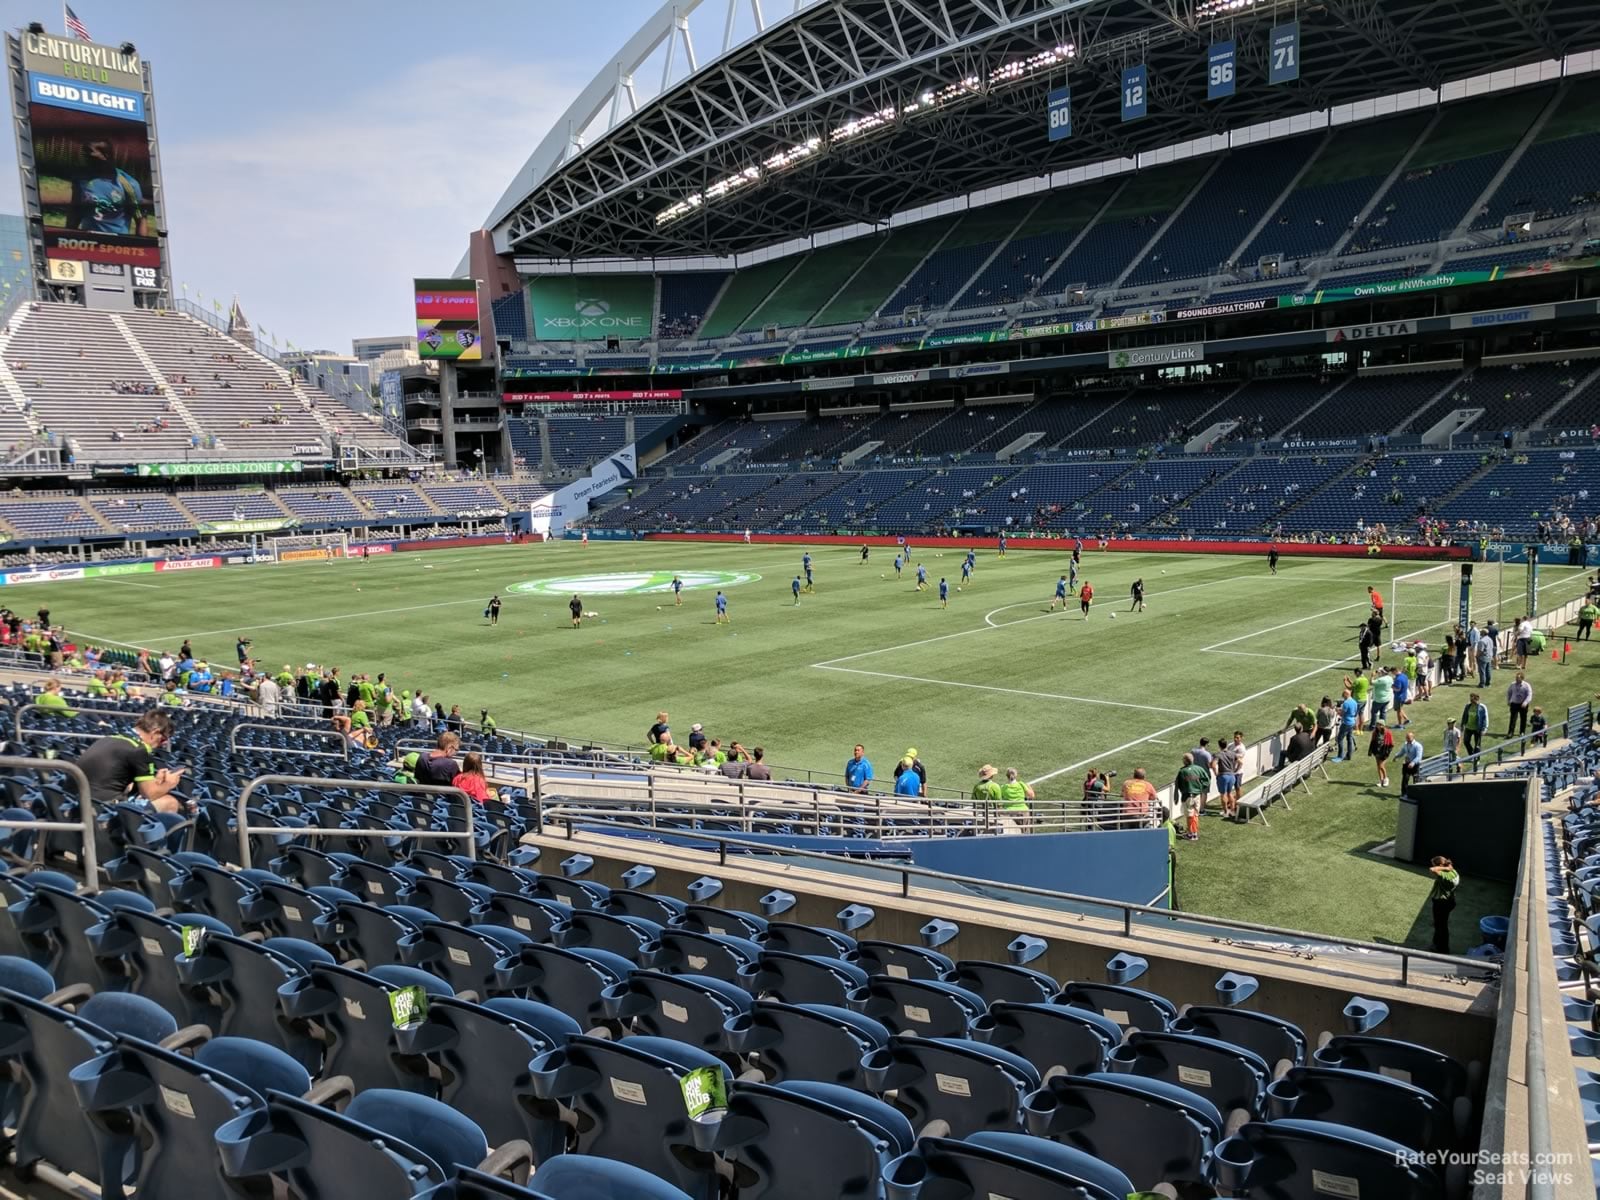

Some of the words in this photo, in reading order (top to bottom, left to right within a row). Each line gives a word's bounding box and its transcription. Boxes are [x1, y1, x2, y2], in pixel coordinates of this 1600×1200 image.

[27, 33, 139, 74] CENTURYLINK
[1274, 46, 1294, 70] 71
[64, 62, 108, 84] FIELD
[1210, 62, 1233, 86] 96
[38, 80, 80, 100] BUD
[82, 89, 136, 112] LIGHT
[1125, 86, 1142, 108] 12
[1050, 107, 1068, 128] 80
[58, 238, 98, 251] ROOT
[99, 244, 145, 256] SPORTS
[134, 267, 156, 278] Q13
[136, 276, 156, 286] FOX
[1354, 286, 1375, 296] Own
[1377, 283, 1396, 293] Your
[1398, 275, 1455, 291] #NWhealthy
[1177, 300, 1266, 319] #SOUNDERSMATCHDAY
[1472, 314, 1497, 325] BUD
[1497, 311, 1530, 322] LIGHT
[544, 317, 598, 328] XBOX
[598, 316, 643, 327] ONE
[1076, 321, 1093, 332] 25:08
[1352, 322, 1408, 338] DELTA
[1026, 326, 1052, 336] SOUNDERS
[1132, 348, 1195, 364] CenturyLink
[884, 374, 914, 384] verizon
[172, 464, 203, 475] XBOX
[205, 463, 240, 474] GREEN
[244, 462, 273, 473] ZONE
[574, 487, 592, 500] Dream
[592, 474, 618, 490] Fearlessly
[396, 992, 414, 1002] JOIN
[396, 1006, 420, 1020] CLUB
[688, 1093, 710, 1112] CLUB
